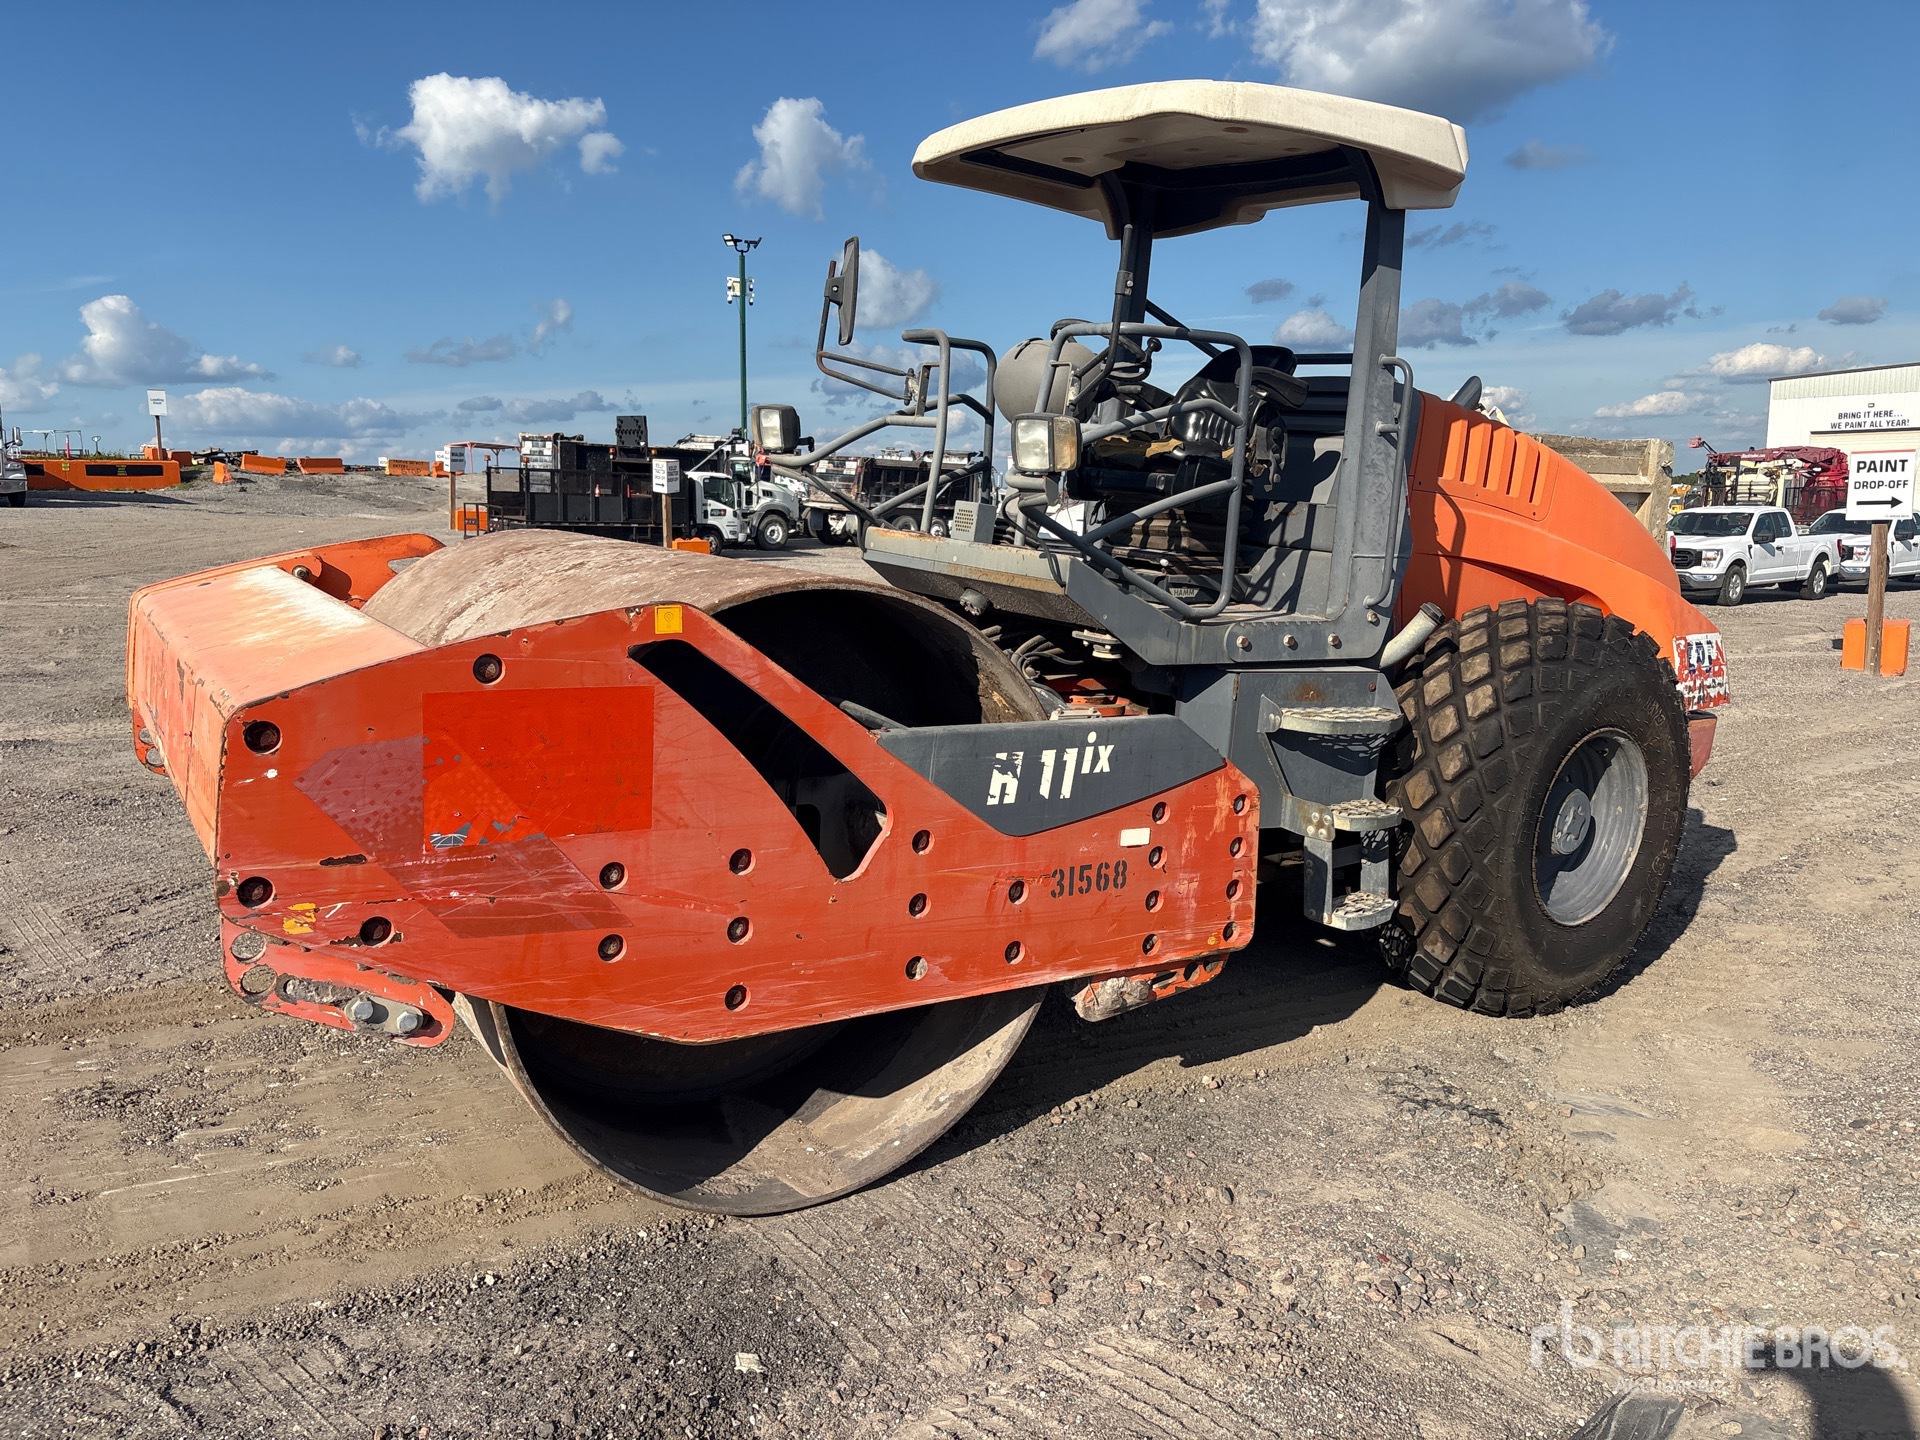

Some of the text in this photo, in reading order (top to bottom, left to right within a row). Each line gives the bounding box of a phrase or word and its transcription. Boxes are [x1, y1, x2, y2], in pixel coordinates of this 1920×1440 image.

[1838, 411, 1862, 420] BRING
[1873, 410, 1903, 418] HERE...
[1845, 420, 1867, 429] PAINT
[1869, 420, 1883, 428] ALL
[1886, 419, 1910, 427] YEAR!
[1856, 459, 1909, 473] PAINT
[1854, 480, 1909, 490] DROP-OFF
[1173, 589, 1195, 597] HAMM
[1050, 859, 1128, 899] 31568
